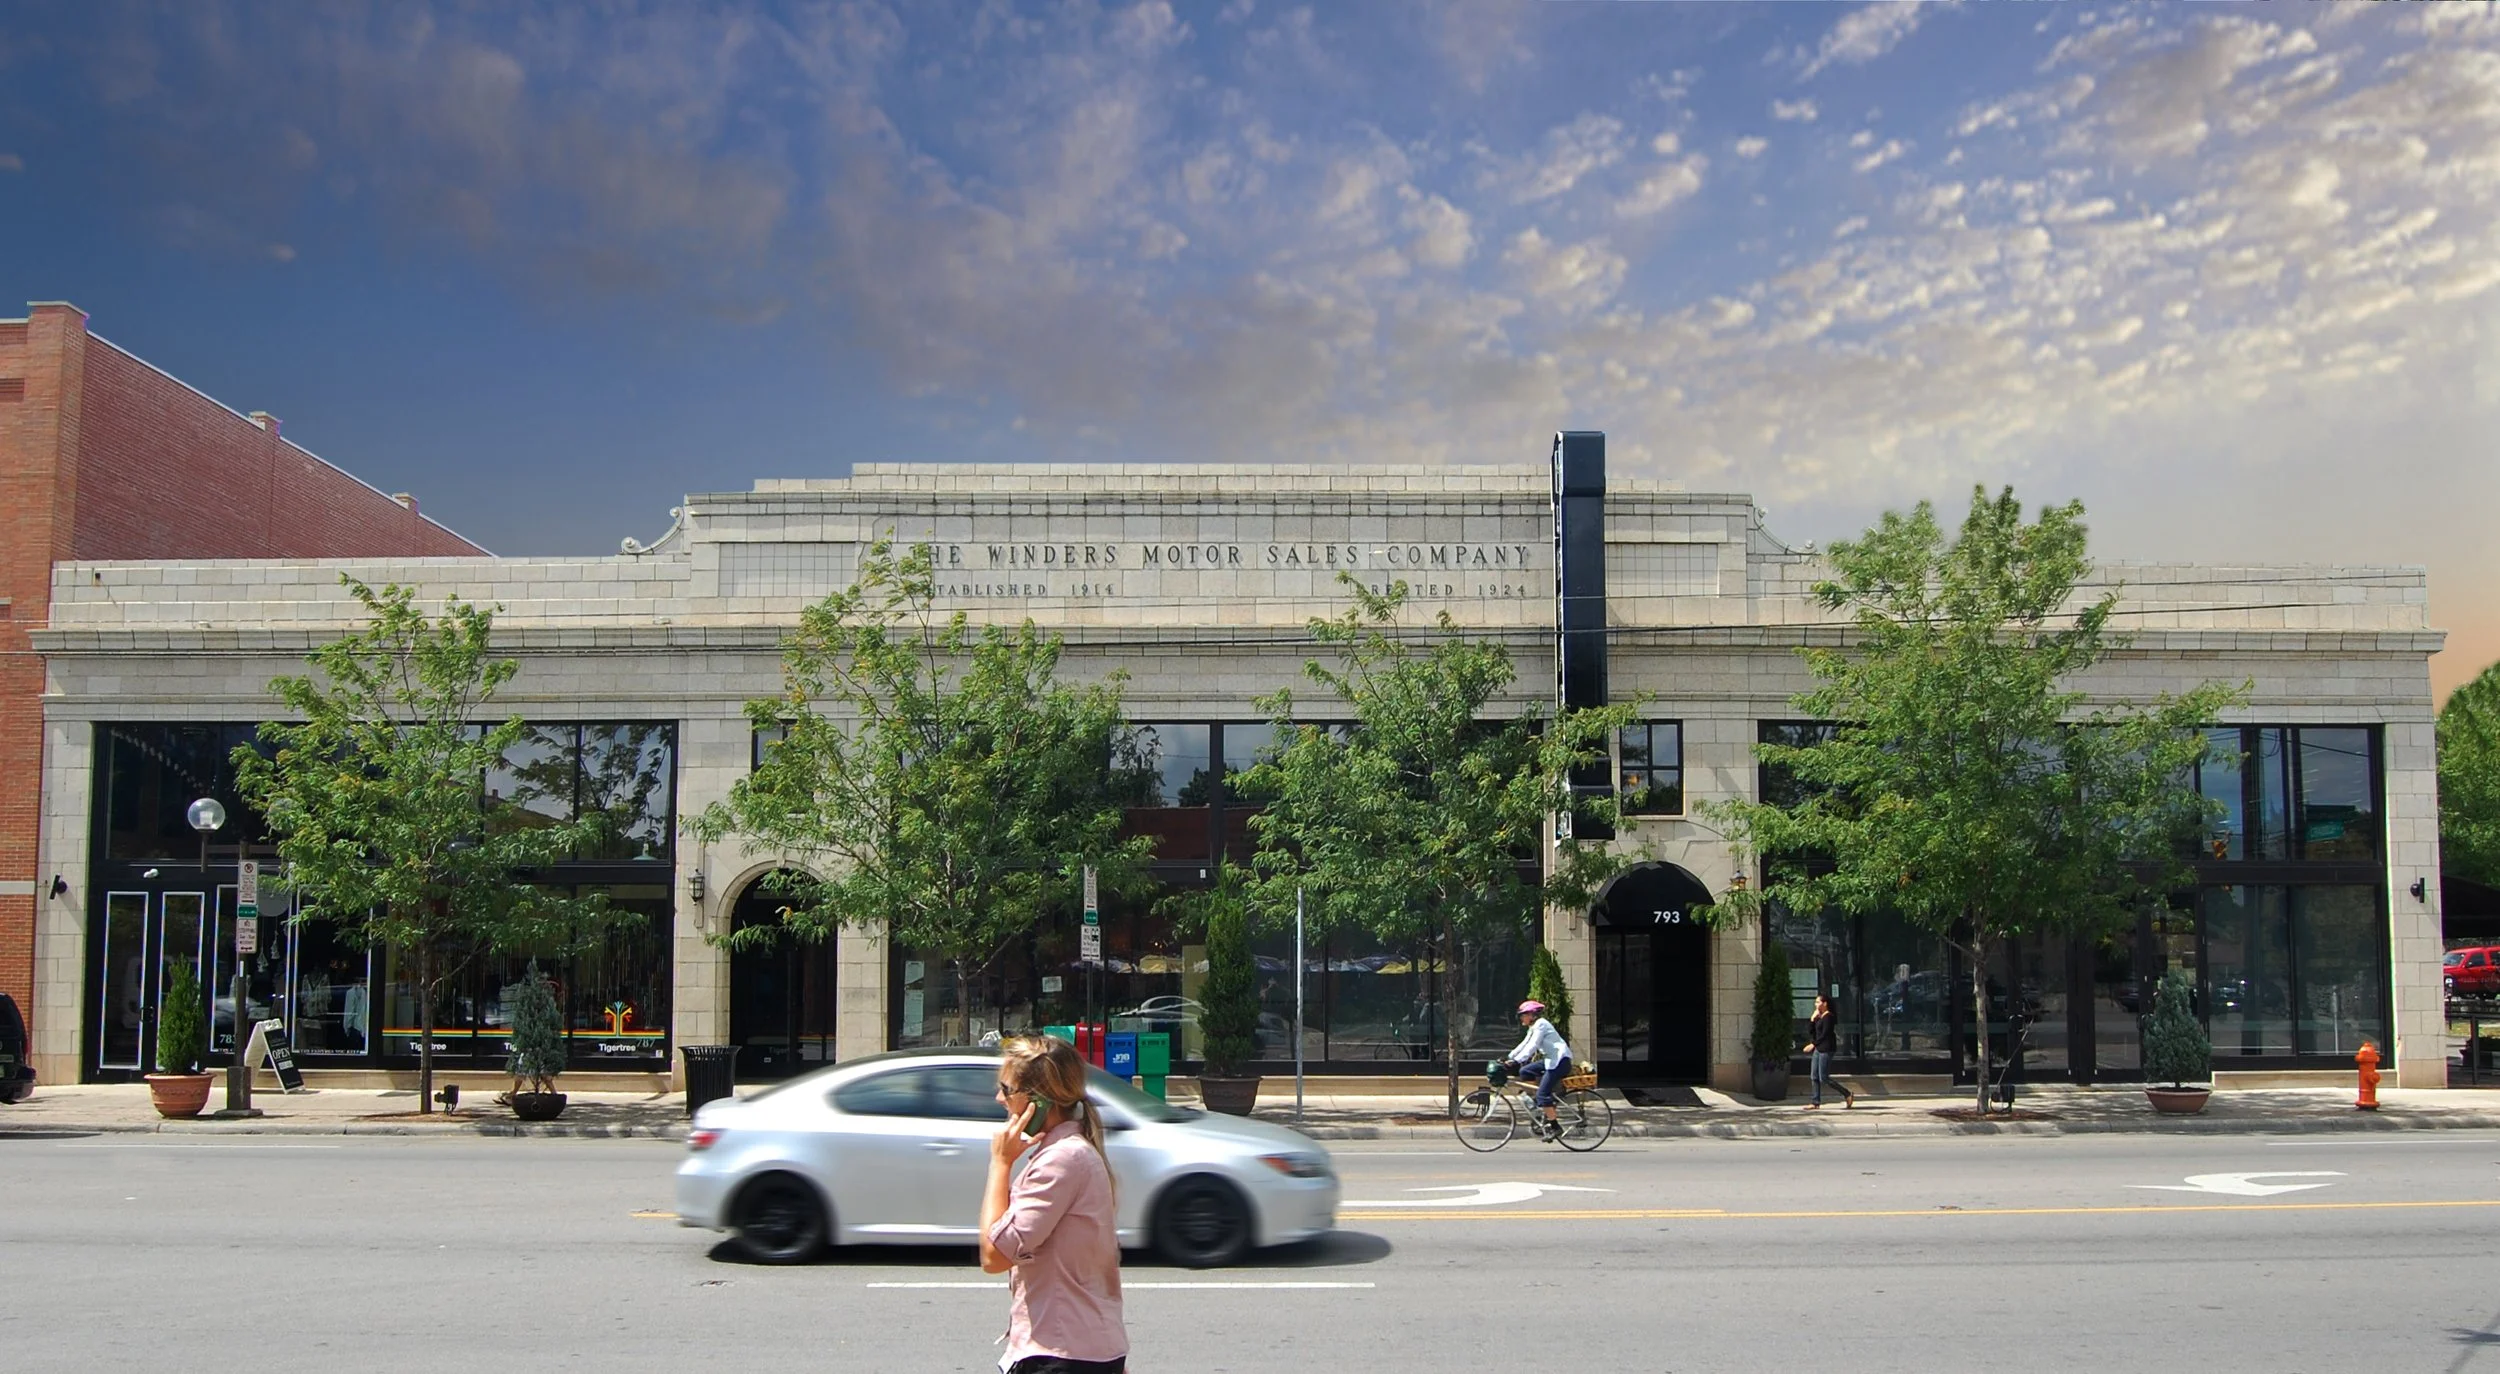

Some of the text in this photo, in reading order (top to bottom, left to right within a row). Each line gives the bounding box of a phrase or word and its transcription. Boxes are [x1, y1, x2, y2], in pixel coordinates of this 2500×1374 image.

[988, 545, 1117, 564] WINDERS
[1143, 545, 1242, 564] MOTOR
[1266, 545, 1359, 564] SALES
[1387, 545, 1528, 565] COMPANY
[924, 584, 1047, 596] TABLISHED
[1366, 584, 1526, 596] RETED 1924
[1653, 910, 1680, 924] 793
[271, 1046, 290, 1060] OPEN
[409, 1042, 447, 1052] Tigtree
[598, 1043, 636, 1053] Tigertree
